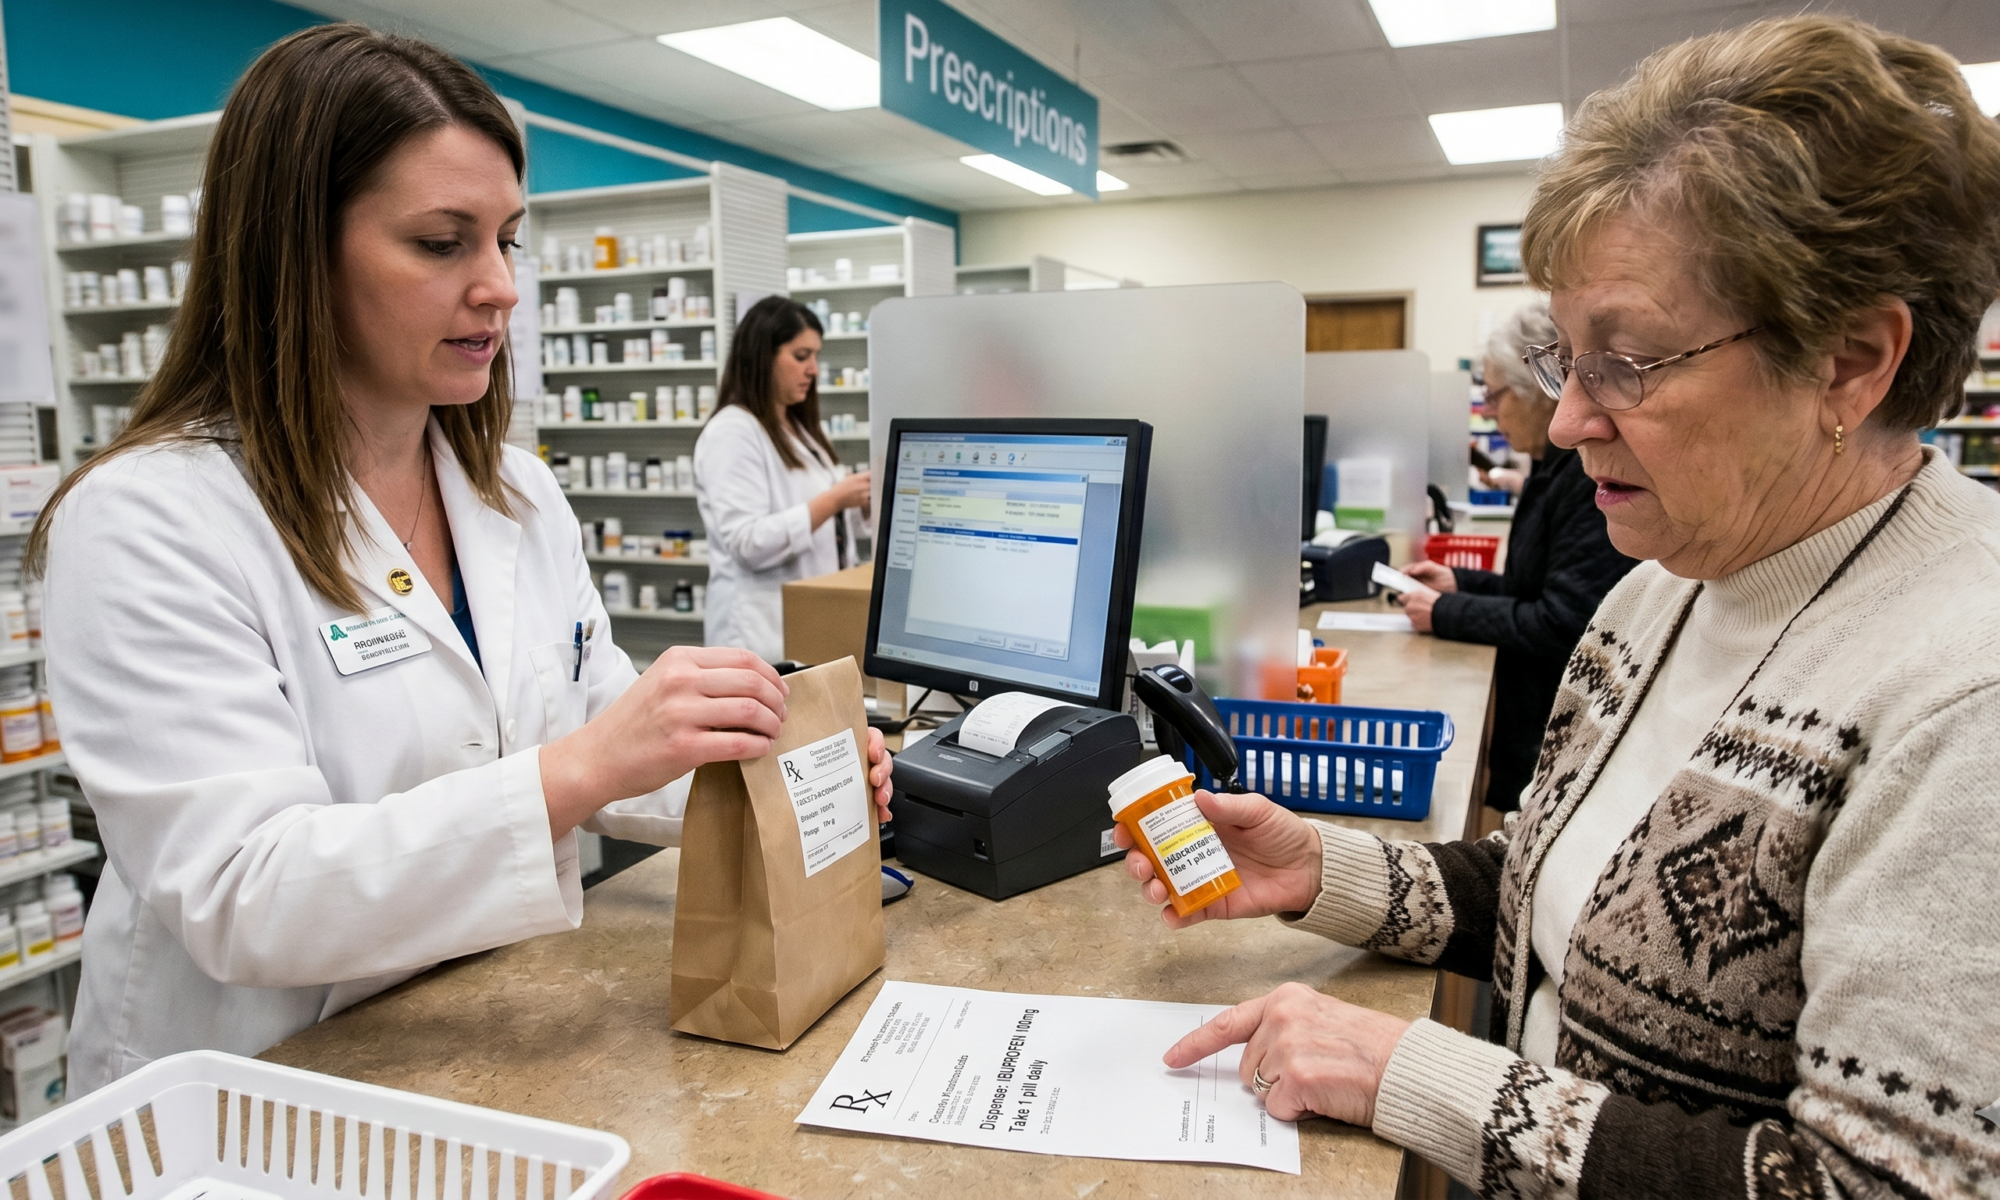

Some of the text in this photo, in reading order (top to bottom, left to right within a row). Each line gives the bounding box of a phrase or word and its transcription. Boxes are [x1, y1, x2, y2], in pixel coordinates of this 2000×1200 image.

[905, 12, 1087, 166] Prescriptions
[979, 1008, 1040, 1130] Dispense: IBUPROFEN 100mg
[1026, 1058, 1049, 1080] daily
[829, 1089, 893, 1114] Rx
[1021, 1082, 1038, 1097] pill
[1008, 1108, 1031, 1132] Take
